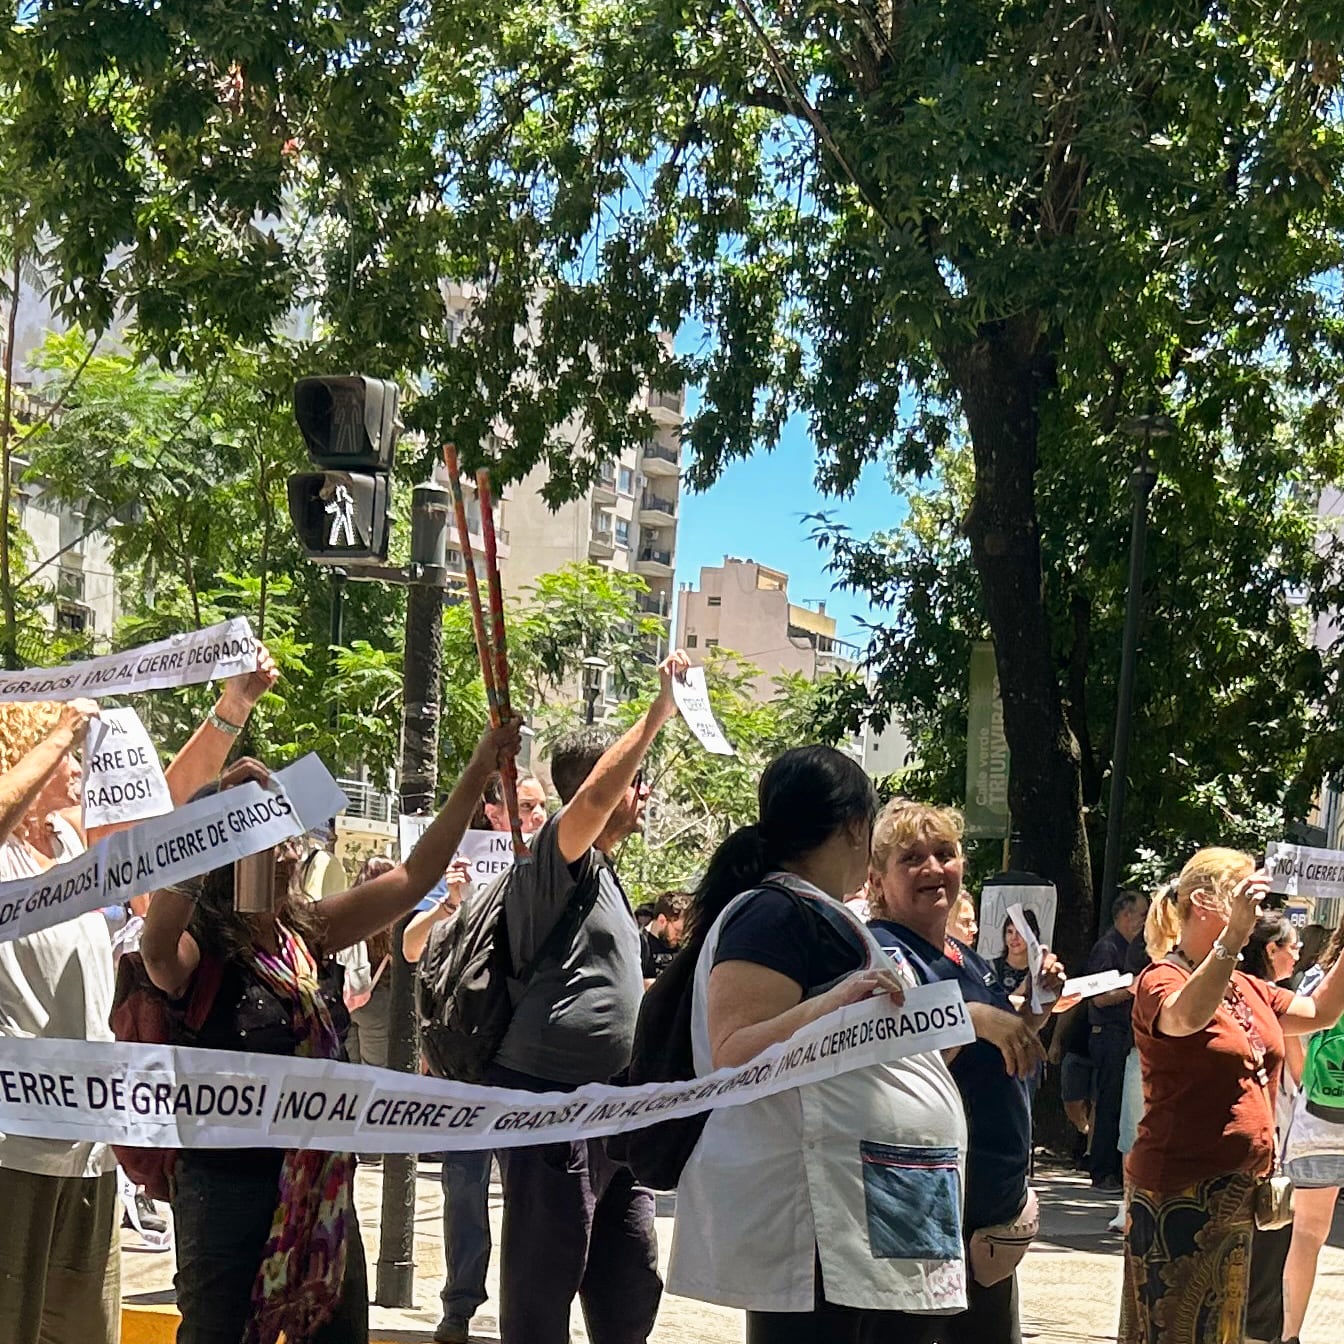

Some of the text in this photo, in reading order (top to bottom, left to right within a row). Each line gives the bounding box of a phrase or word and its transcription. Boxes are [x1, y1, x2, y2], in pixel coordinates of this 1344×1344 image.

[3, 675, 77, 694] GRADOS!
[82, 669, 115, 687] ¡NO
[115, 663, 134, 678] AL
[137, 651, 185, 675] CIERRE
[110, 719, 128, 736] AL
[127, 746, 149, 766] DE
[85, 778, 153, 808] RADOS!
[24, 862, 100, 914] GRADOS!
[136, 854, 154, 880] AL
[156, 828, 207, 868] CIERRE
[207, 820, 229, 847] DE
[228, 794, 292, 833] GRADOS
[1306, 863, 1338, 881] CIERRE
[87, 1076, 126, 1111] DE
[131, 1081, 267, 1117] GRADOS!
[272, 1090, 326, 1124] ¡NO
[328, 1093, 359, 1122] AL
[366, 1098, 454, 1128] CIERRE
[448, 1105, 486, 1128] DE
[776, 1046, 803, 1079] ¡NO
[802, 1041, 817, 1065] AL
[820, 1023, 859, 1058] CIERRE
[859, 1018, 875, 1044] DE
[874, 1001, 967, 1041] GRADOS!
